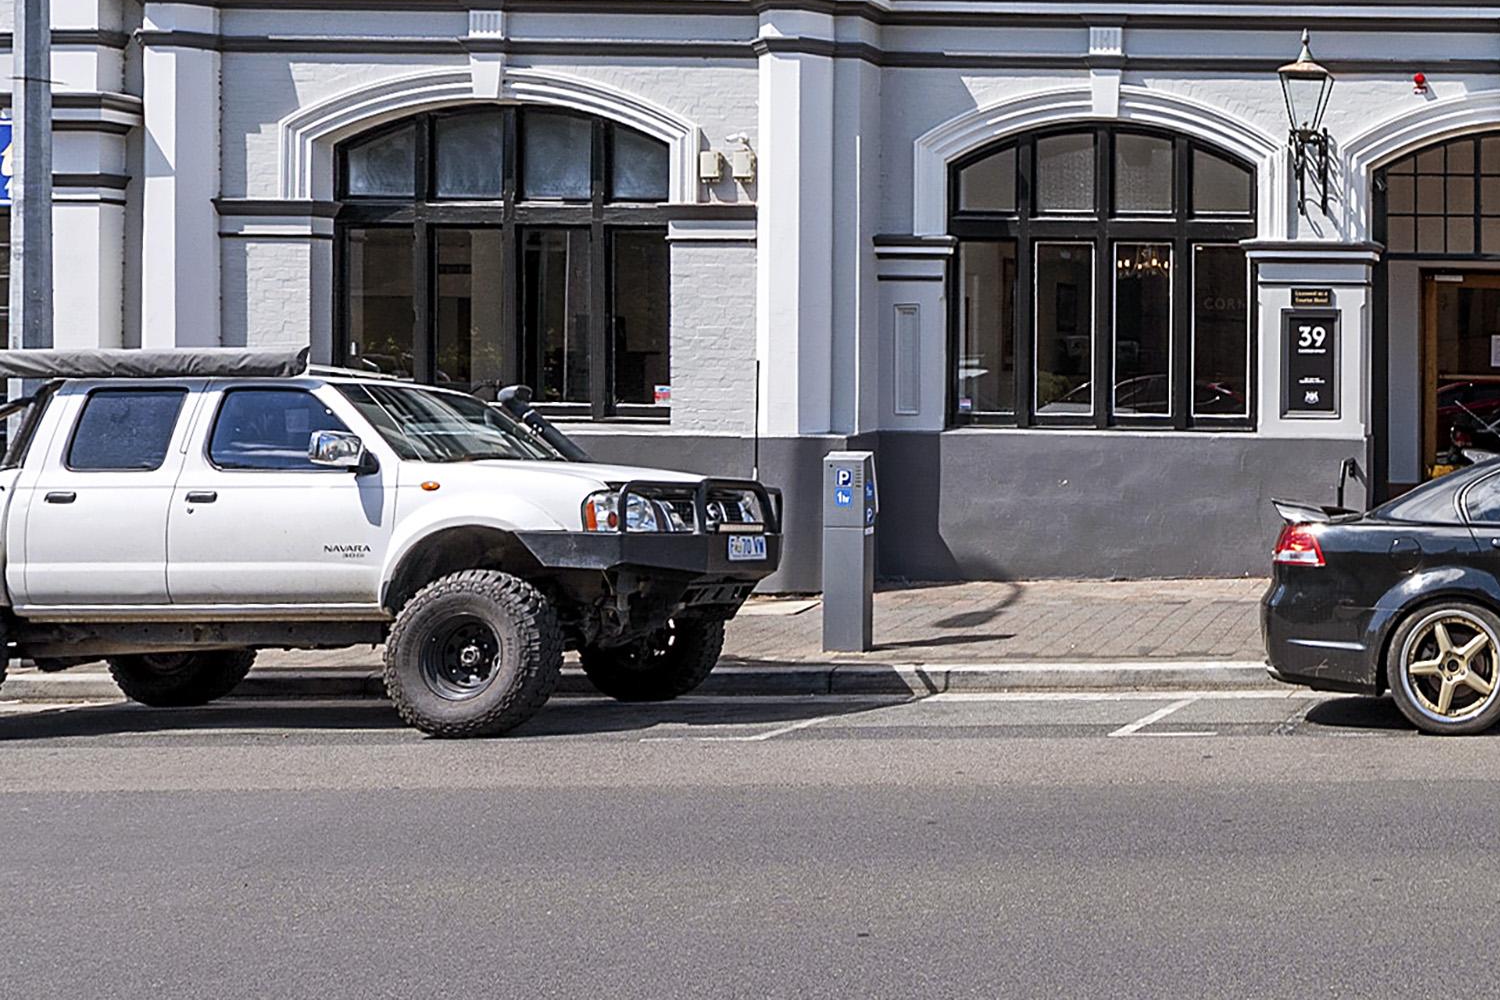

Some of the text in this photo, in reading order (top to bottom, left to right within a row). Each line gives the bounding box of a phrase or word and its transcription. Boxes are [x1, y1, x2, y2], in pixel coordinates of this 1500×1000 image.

[1298, 326, 1326, 348] 39
[839, 470, 850, 486] P
[323, 544, 371, 552] NAVARA
